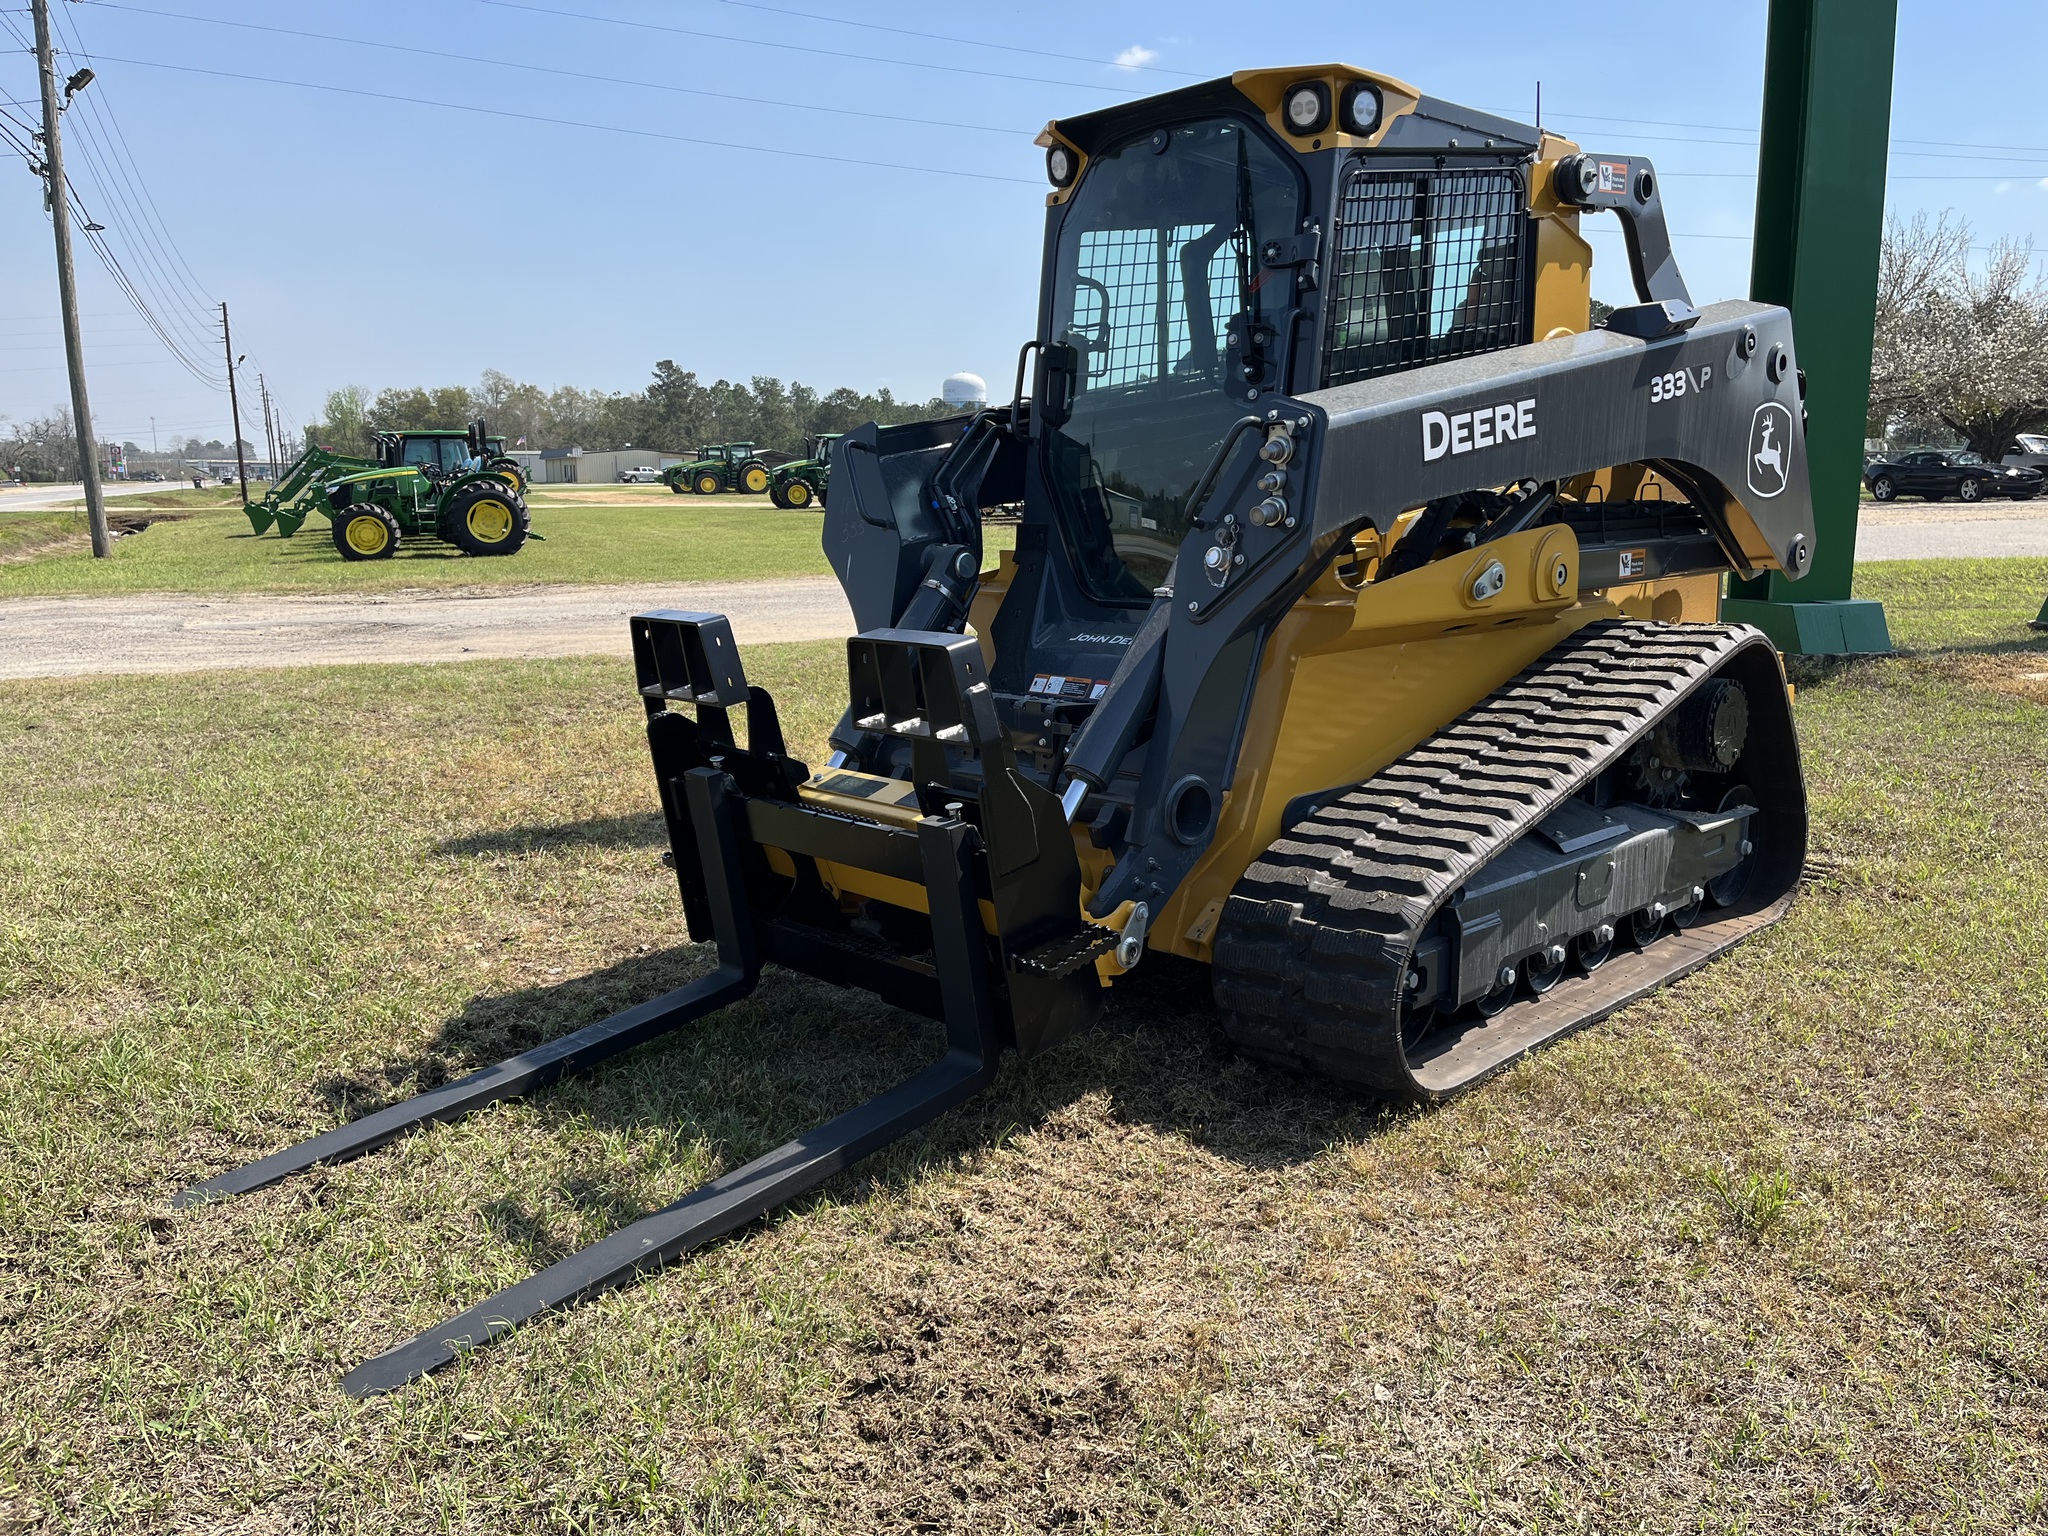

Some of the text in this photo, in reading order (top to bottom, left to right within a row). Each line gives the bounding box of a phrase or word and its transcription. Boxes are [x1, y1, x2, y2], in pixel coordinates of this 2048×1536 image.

[1422, 398, 1537, 462] DEERE
[1069, 632, 1133, 646] JOHN DE
